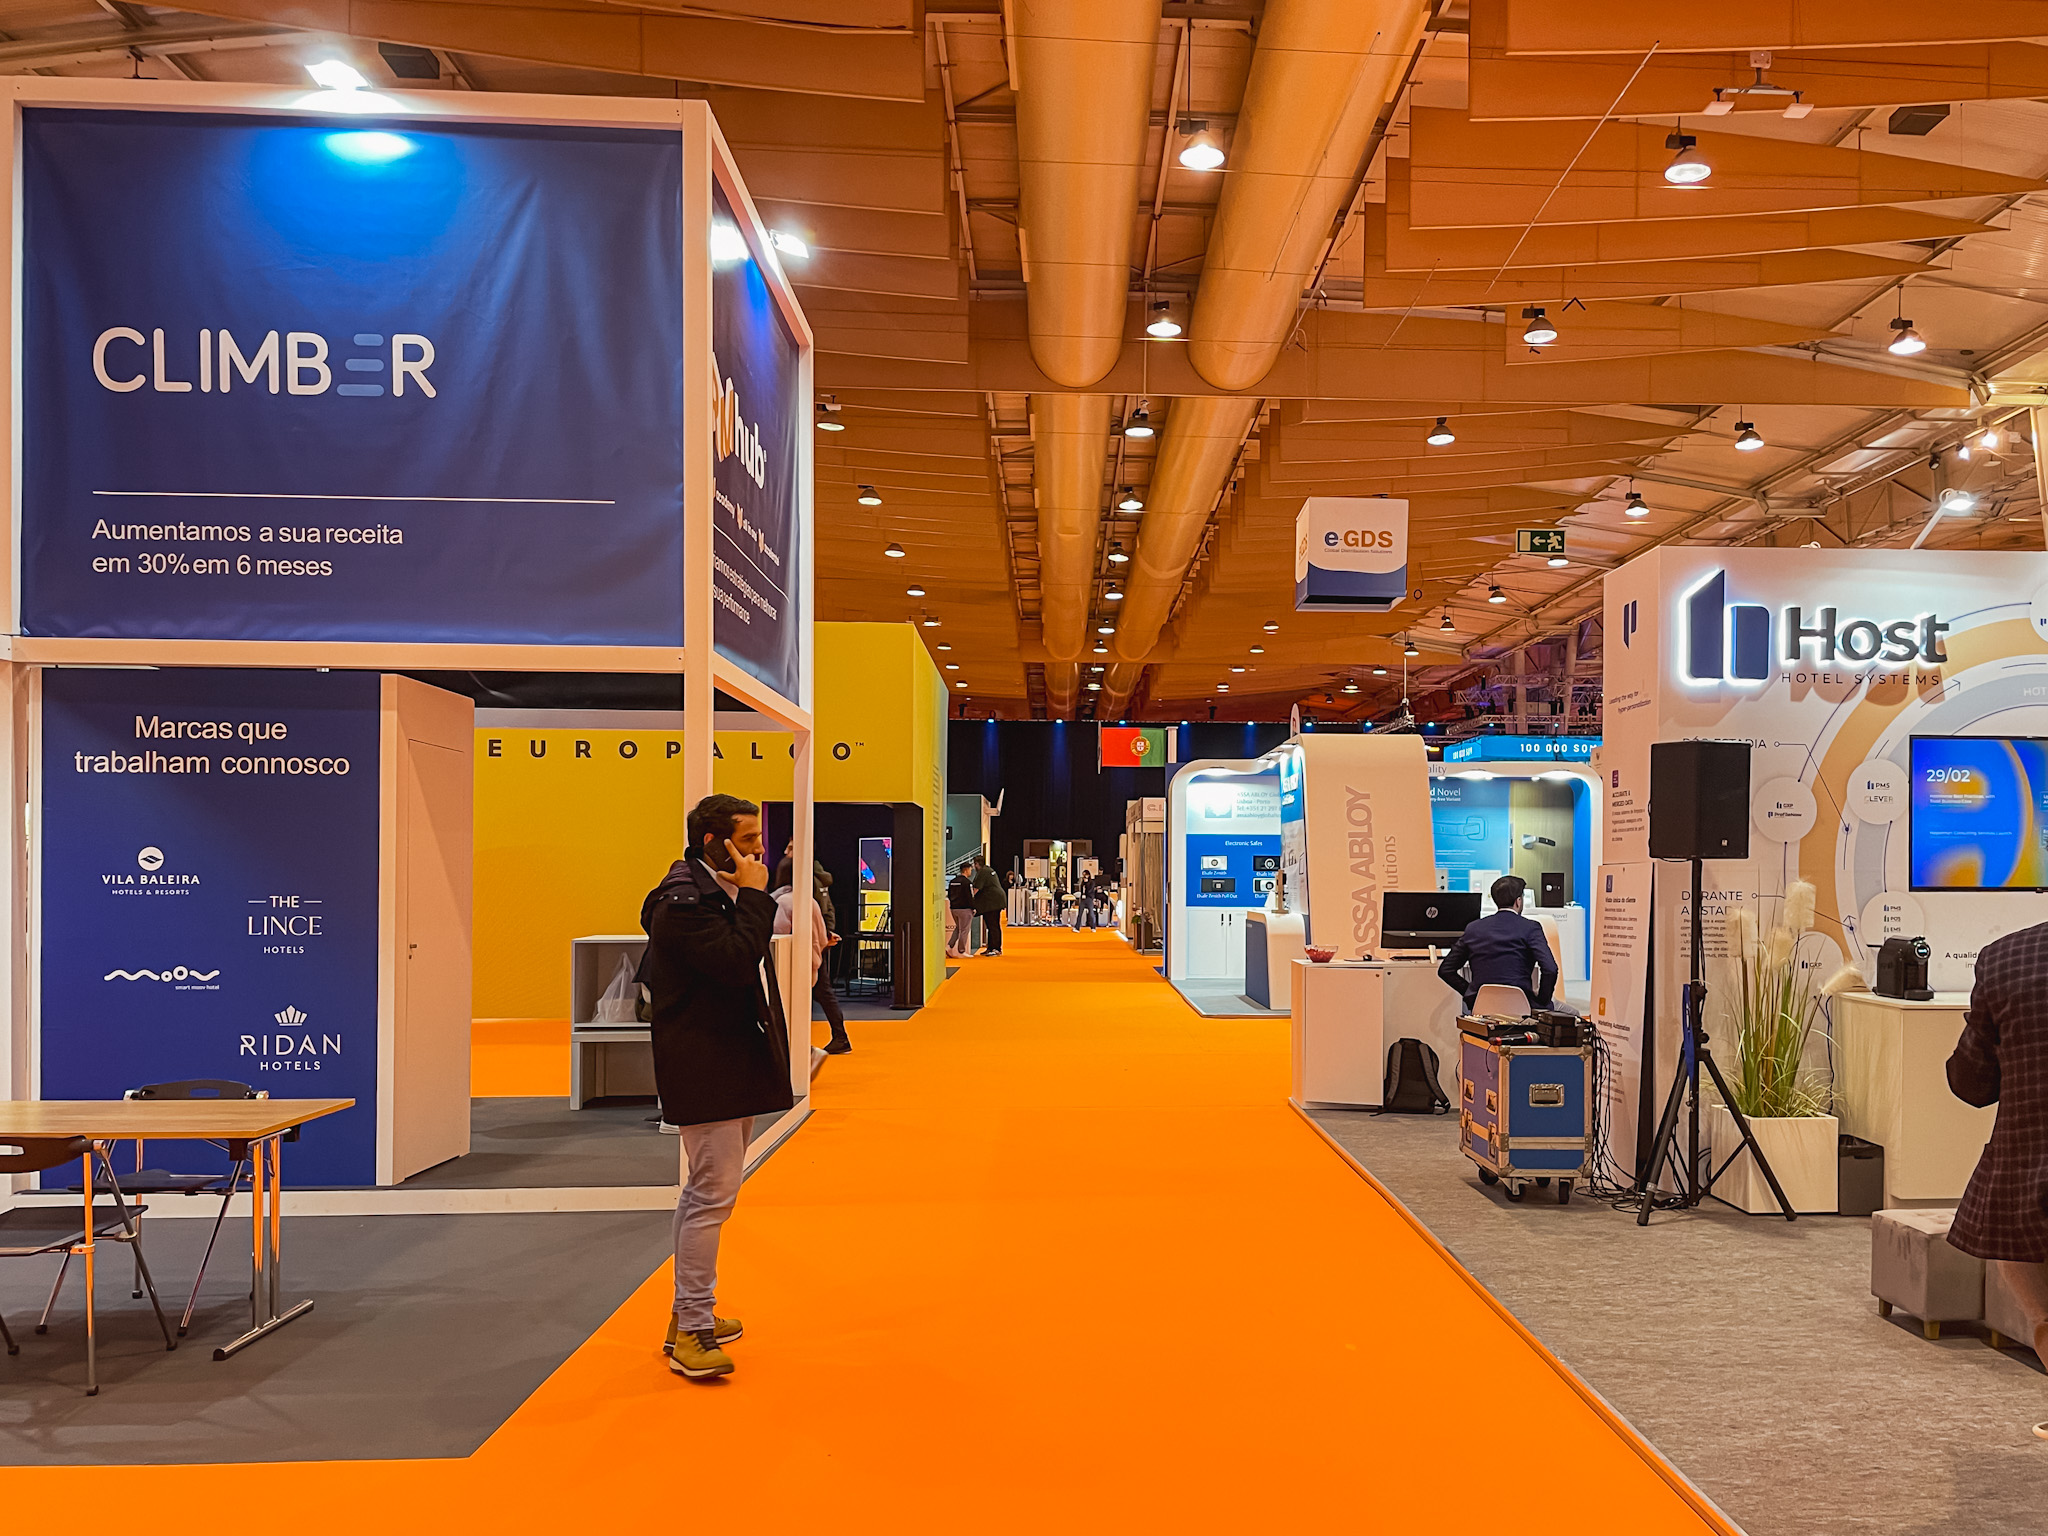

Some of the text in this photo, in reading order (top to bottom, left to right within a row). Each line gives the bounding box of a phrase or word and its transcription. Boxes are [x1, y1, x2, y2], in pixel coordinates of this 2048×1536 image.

[92, 326, 437, 398] CLIMBER
[92, 519, 404, 544] Aumentamos a sua receita
[1324, 530, 1393, 548] e-GDS
[92, 553, 333, 576] em 30% em 6 meses
[1785, 607, 1950, 663] Host
[1781, 673, 1940, 686] HOTEL SYSTEMS
[135, 716, 288, 745] Marcas que
[1520, 744, 1540, 753] 100
[1546, 744, 1568, 753] 000
[74, 751, 350, 775] trabalham connosco
[1926, 767, 1971, 783] 29/02
[1437, 788, 1461, 796] Novel
[1345, 785, 1380, 958] ASSA ABLOY
[1382, 835, 1399, 892] lutions
[102, 874, 201, 885] VILA BALEIRA
[269, 896, 300, 908] THE
[1681, 891, 1743, 901] DRANTE
[1426, 906, 1439, 919] hp
[248, 916, 323, 936] LINCE
[263, 946, 305, 954] HOTELS
[240, 1034, 341, 1056] RIDAN
[260, 1061, 321, 1071] HOTELS
